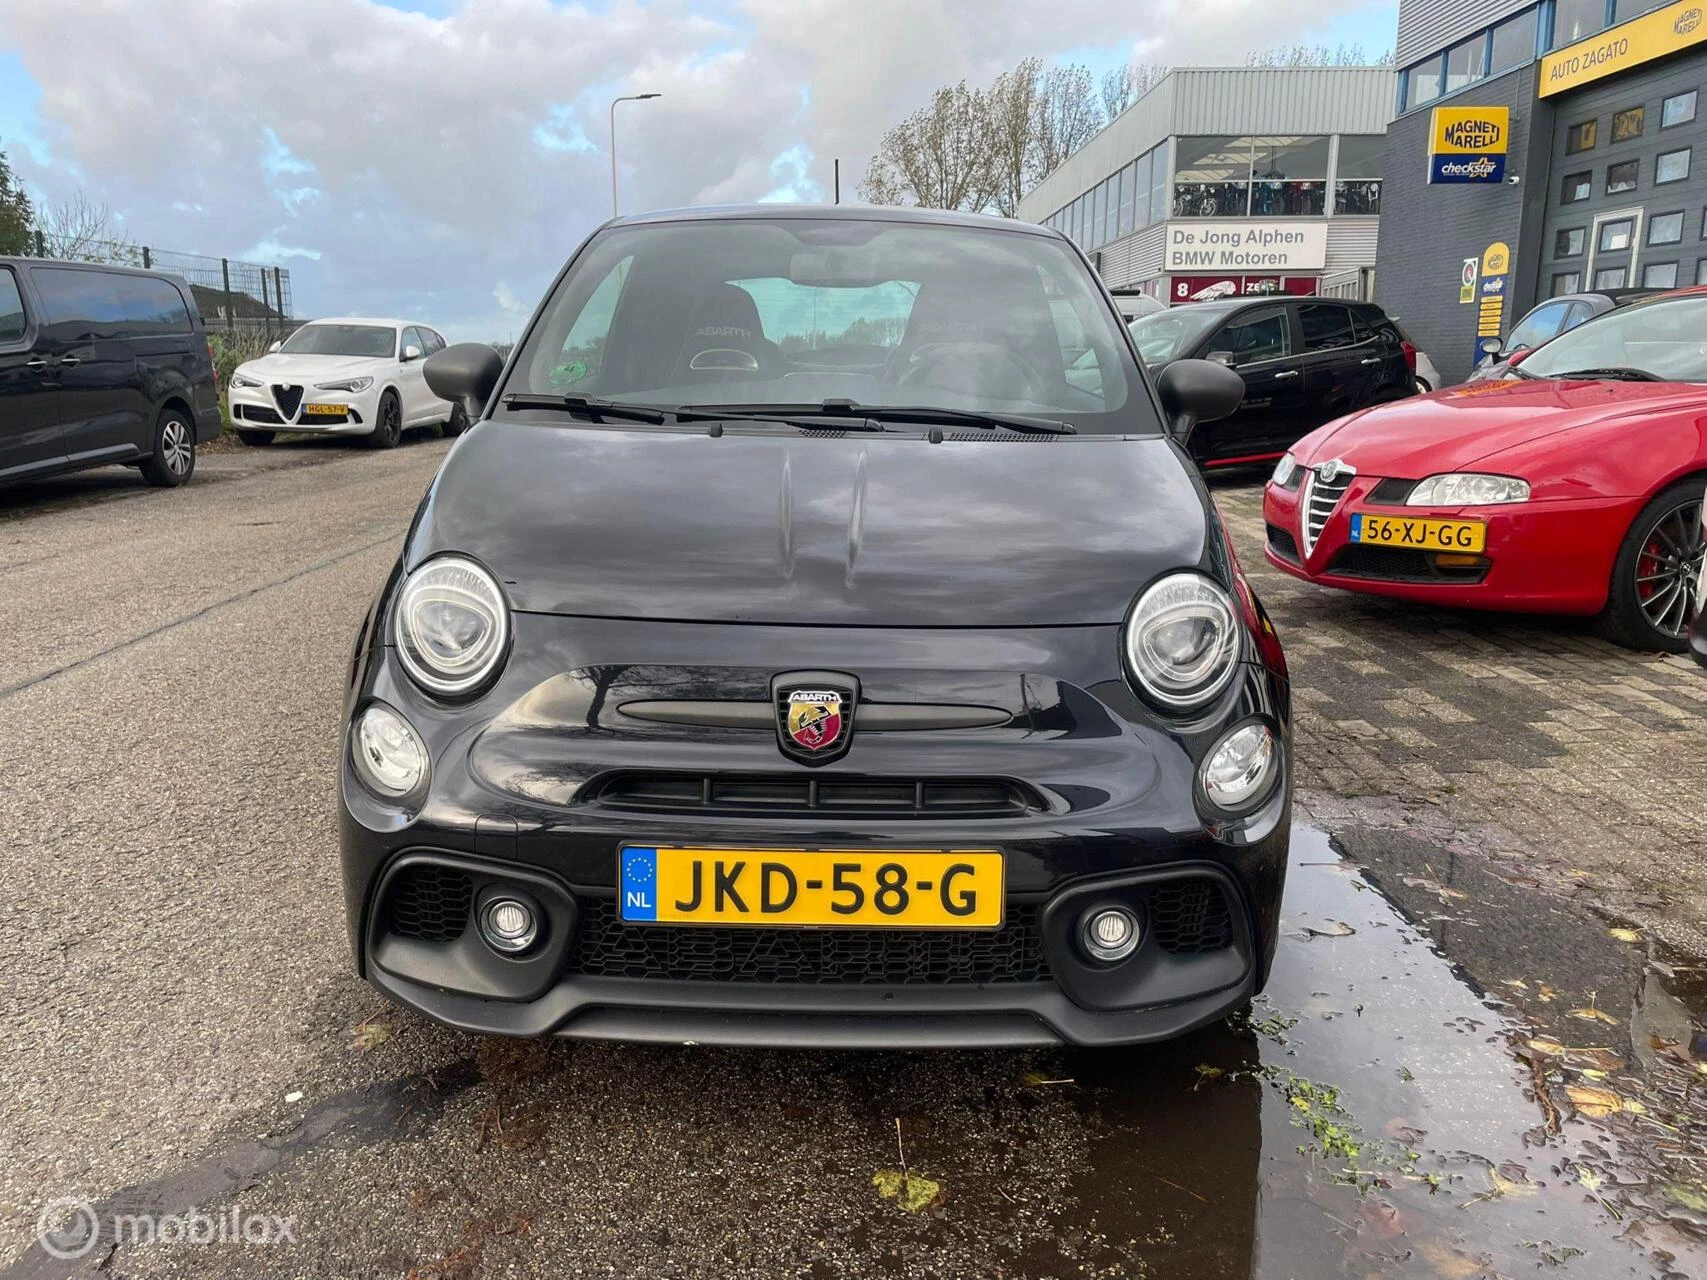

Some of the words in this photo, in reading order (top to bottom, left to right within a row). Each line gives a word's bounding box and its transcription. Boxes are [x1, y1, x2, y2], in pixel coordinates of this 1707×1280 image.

[1550, 57, 1580, 81] AUTO
[1583, 38, 1628, 70] ZAGATO
[1445, 120, 1500, 138] MAGNETI
[1445, 132, 1500, 149] MARELLI
[1441, 161, 1497, 173] checkstar
[1173, 230, 1195, 245] De
[1200, 230, 1241, 247] Jong
[1245, 229, 1304, 247] Alphen
[1172, 251, 1215, 265] BMW
[1219, 250, 1288, 265] Motoren
[696, 326, 752, 337] ABARTH
[309, 405, 345, 413] HGL-57-V
[1367, 520, 1472, 547] 56-XJ-GG
[793, 693, 837, 701] ABARTH
[675, 860, 977, 916] JKD-58-G
[627, 892, 652, 908] NL
